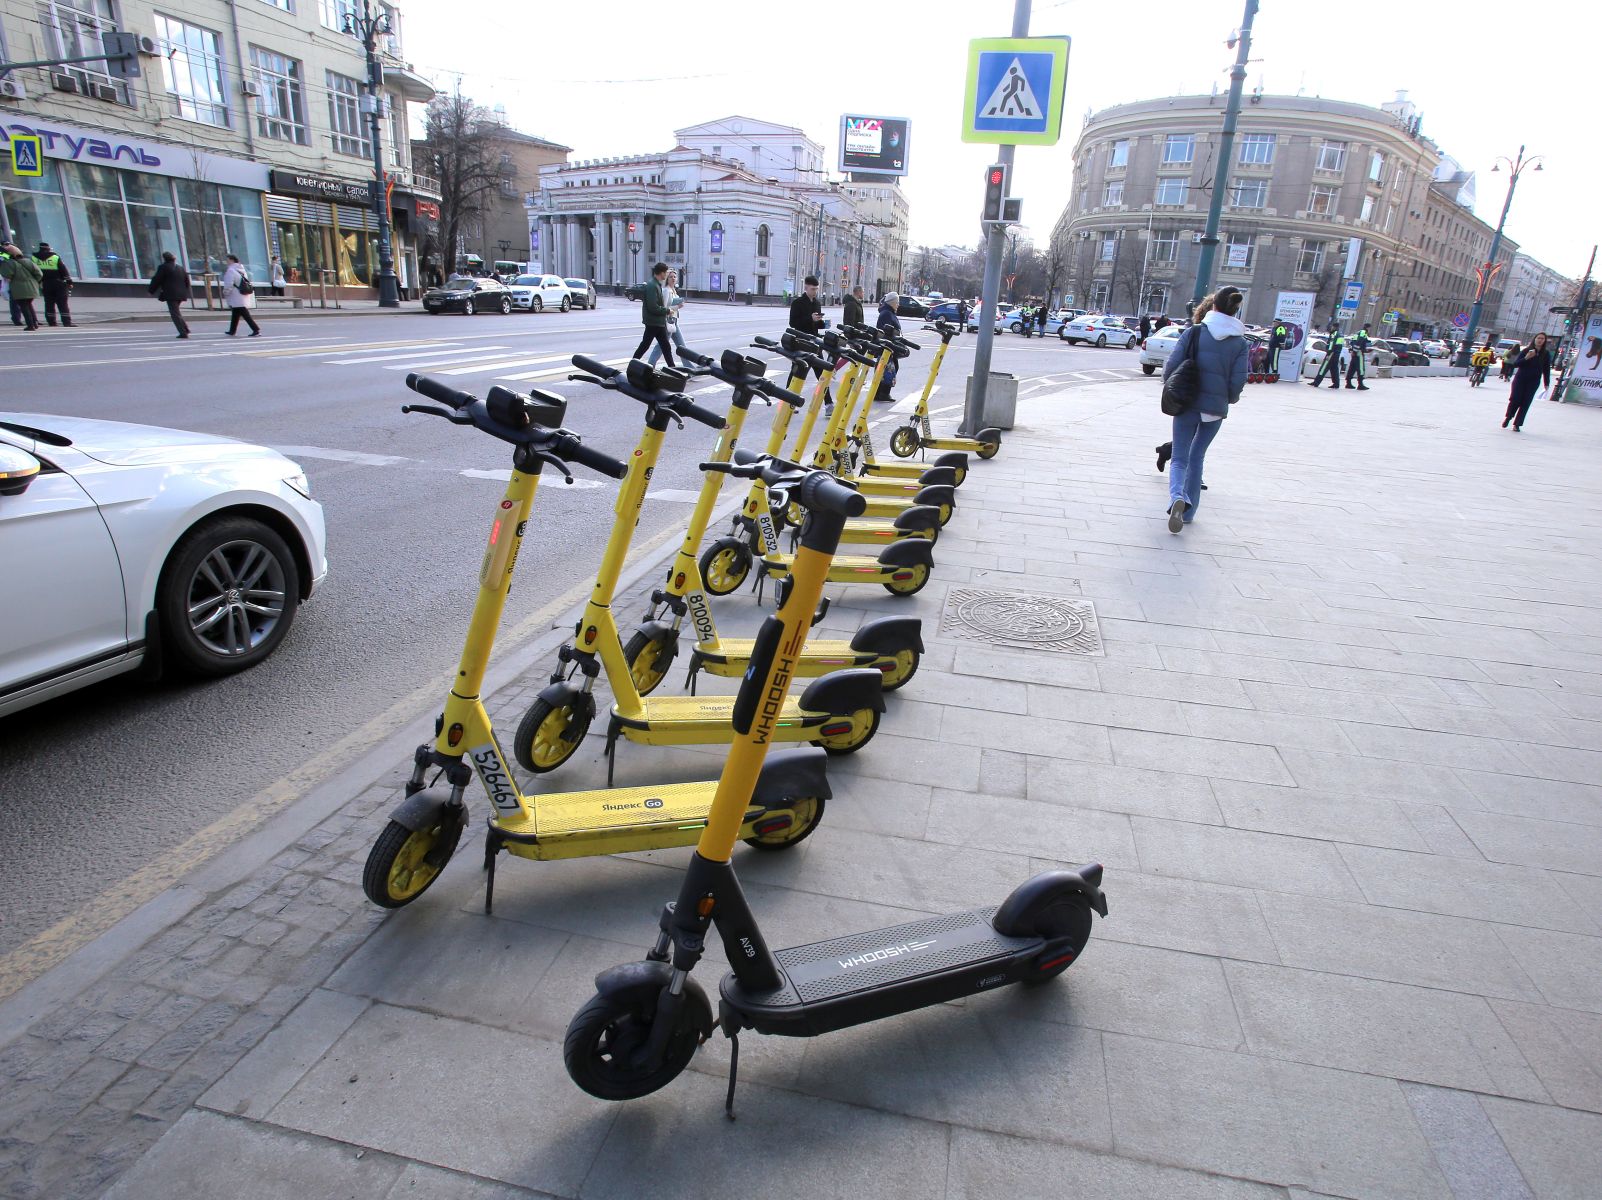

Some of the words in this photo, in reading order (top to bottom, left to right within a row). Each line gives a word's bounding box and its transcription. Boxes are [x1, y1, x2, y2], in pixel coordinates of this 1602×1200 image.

[760, 516, 778, 552] 810932
[690, 594, 715, 641] 810094
[753, 659, 793, 744] WHOOSH
[475, 750, 520, 809] 526467
[602, 803, 642, 811] Яндекс
[645, 799, 662, 808] Go
[739, 937, 756, 958] AV39
[838, 944, 911, 969] WHOOSH
